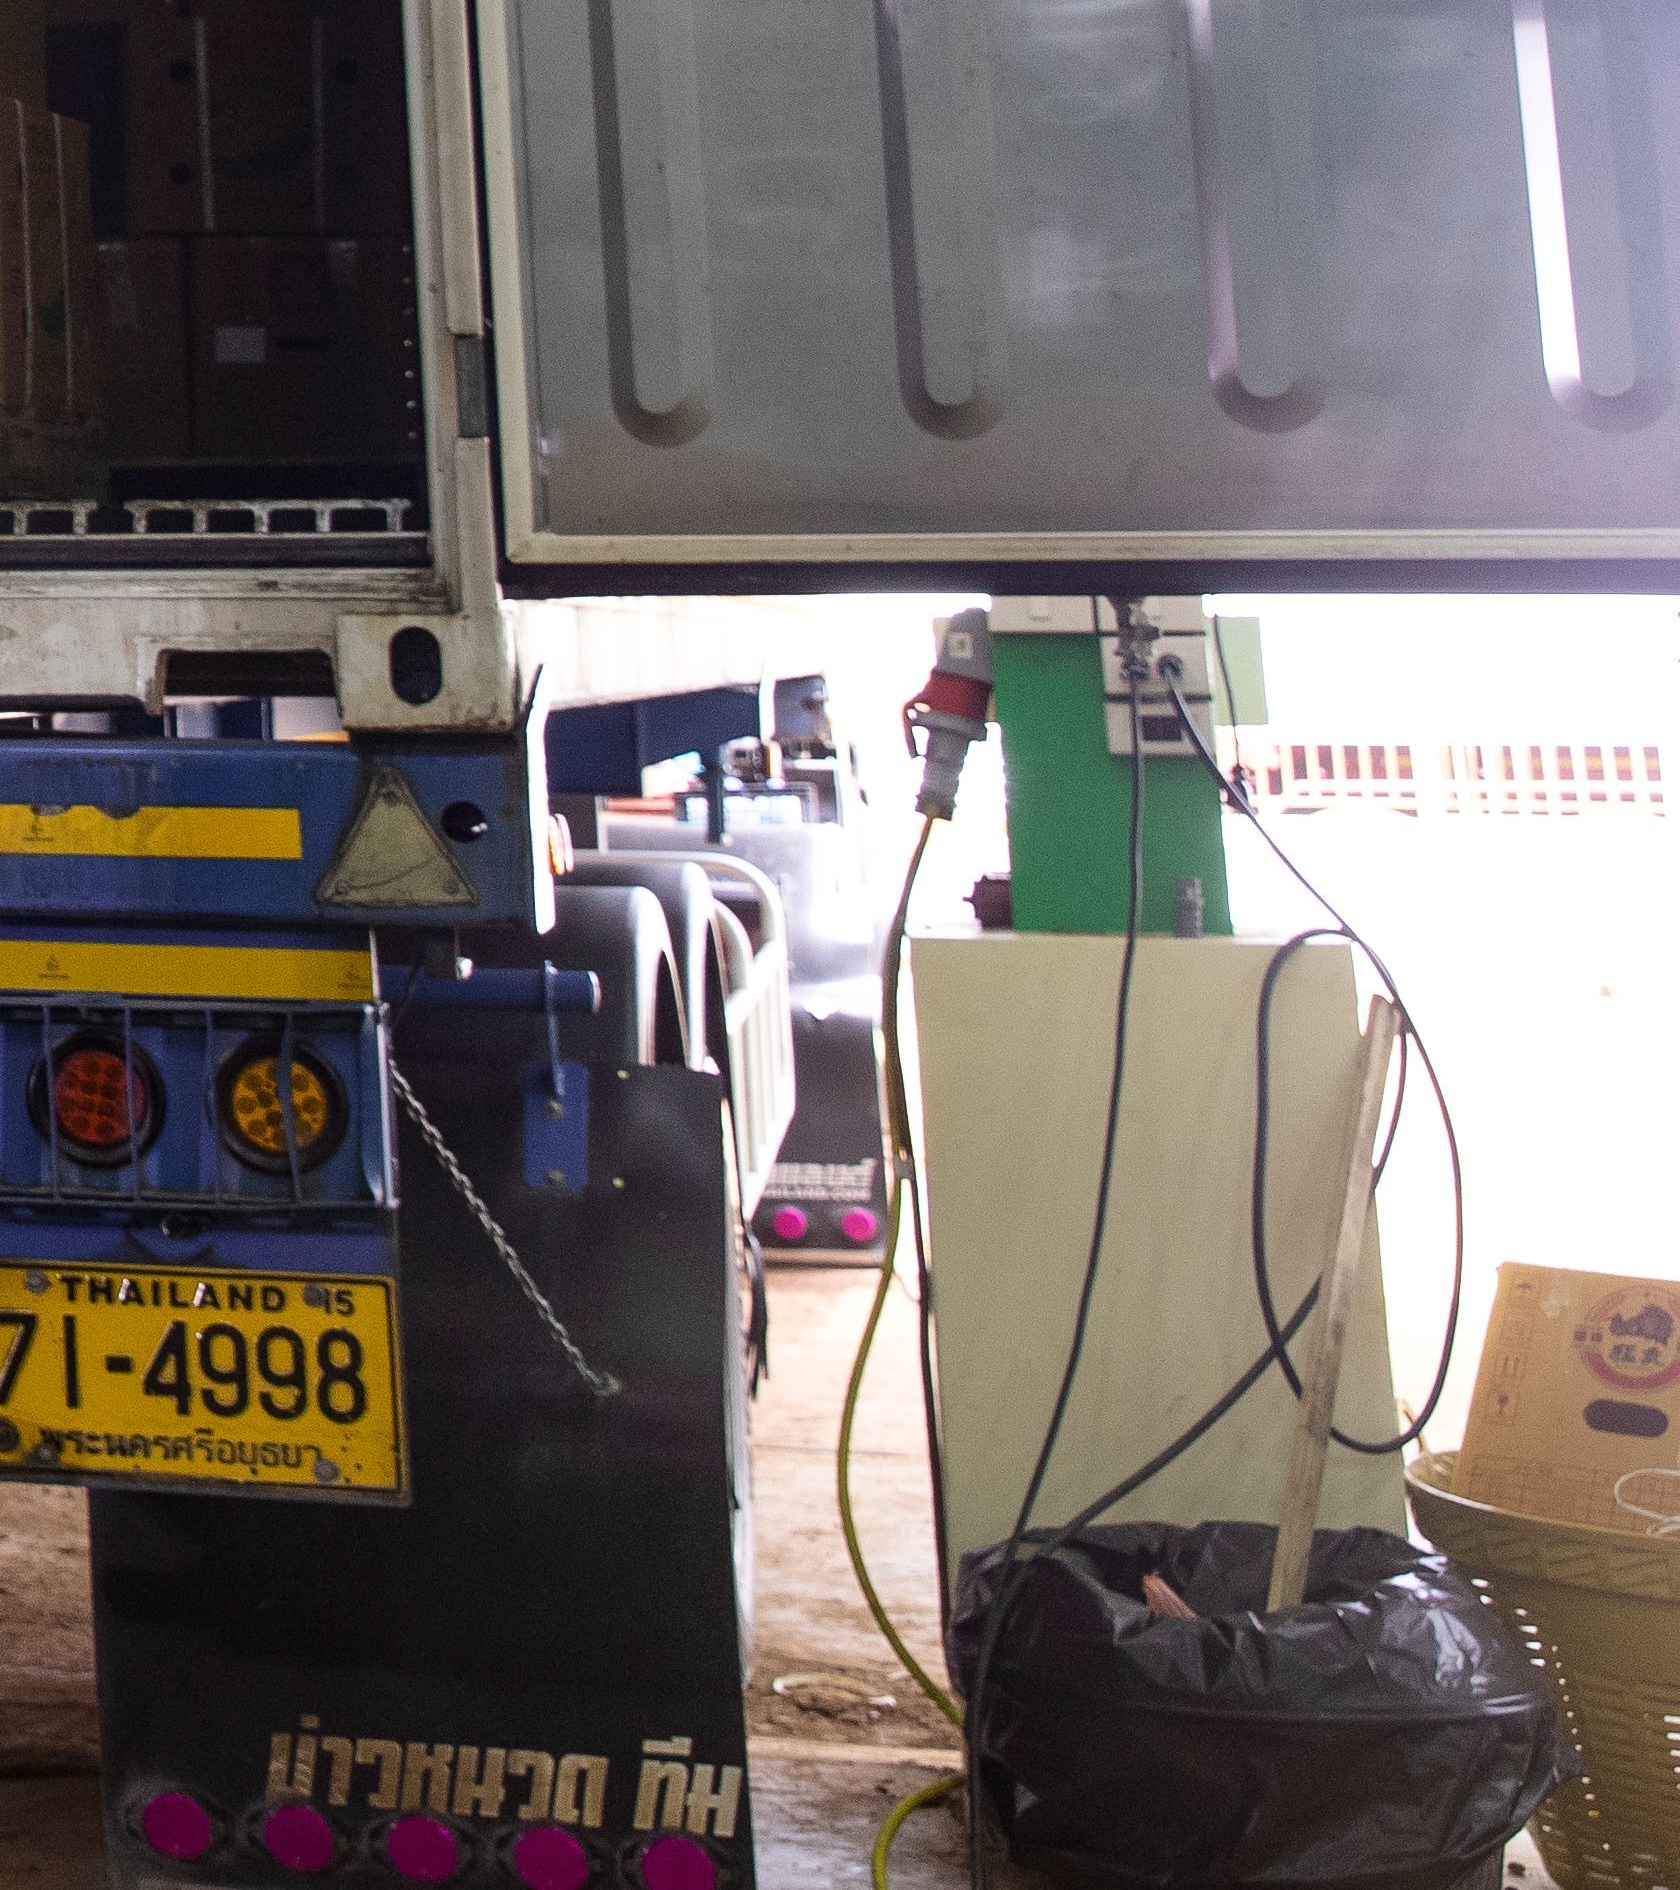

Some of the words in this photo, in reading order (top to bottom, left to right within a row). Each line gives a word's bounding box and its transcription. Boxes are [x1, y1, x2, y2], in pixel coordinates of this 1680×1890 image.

[60, 1274, 287, 1313] THAILAND
[40, 1426, 323, 1476] พระนครศรีอยุธยา
